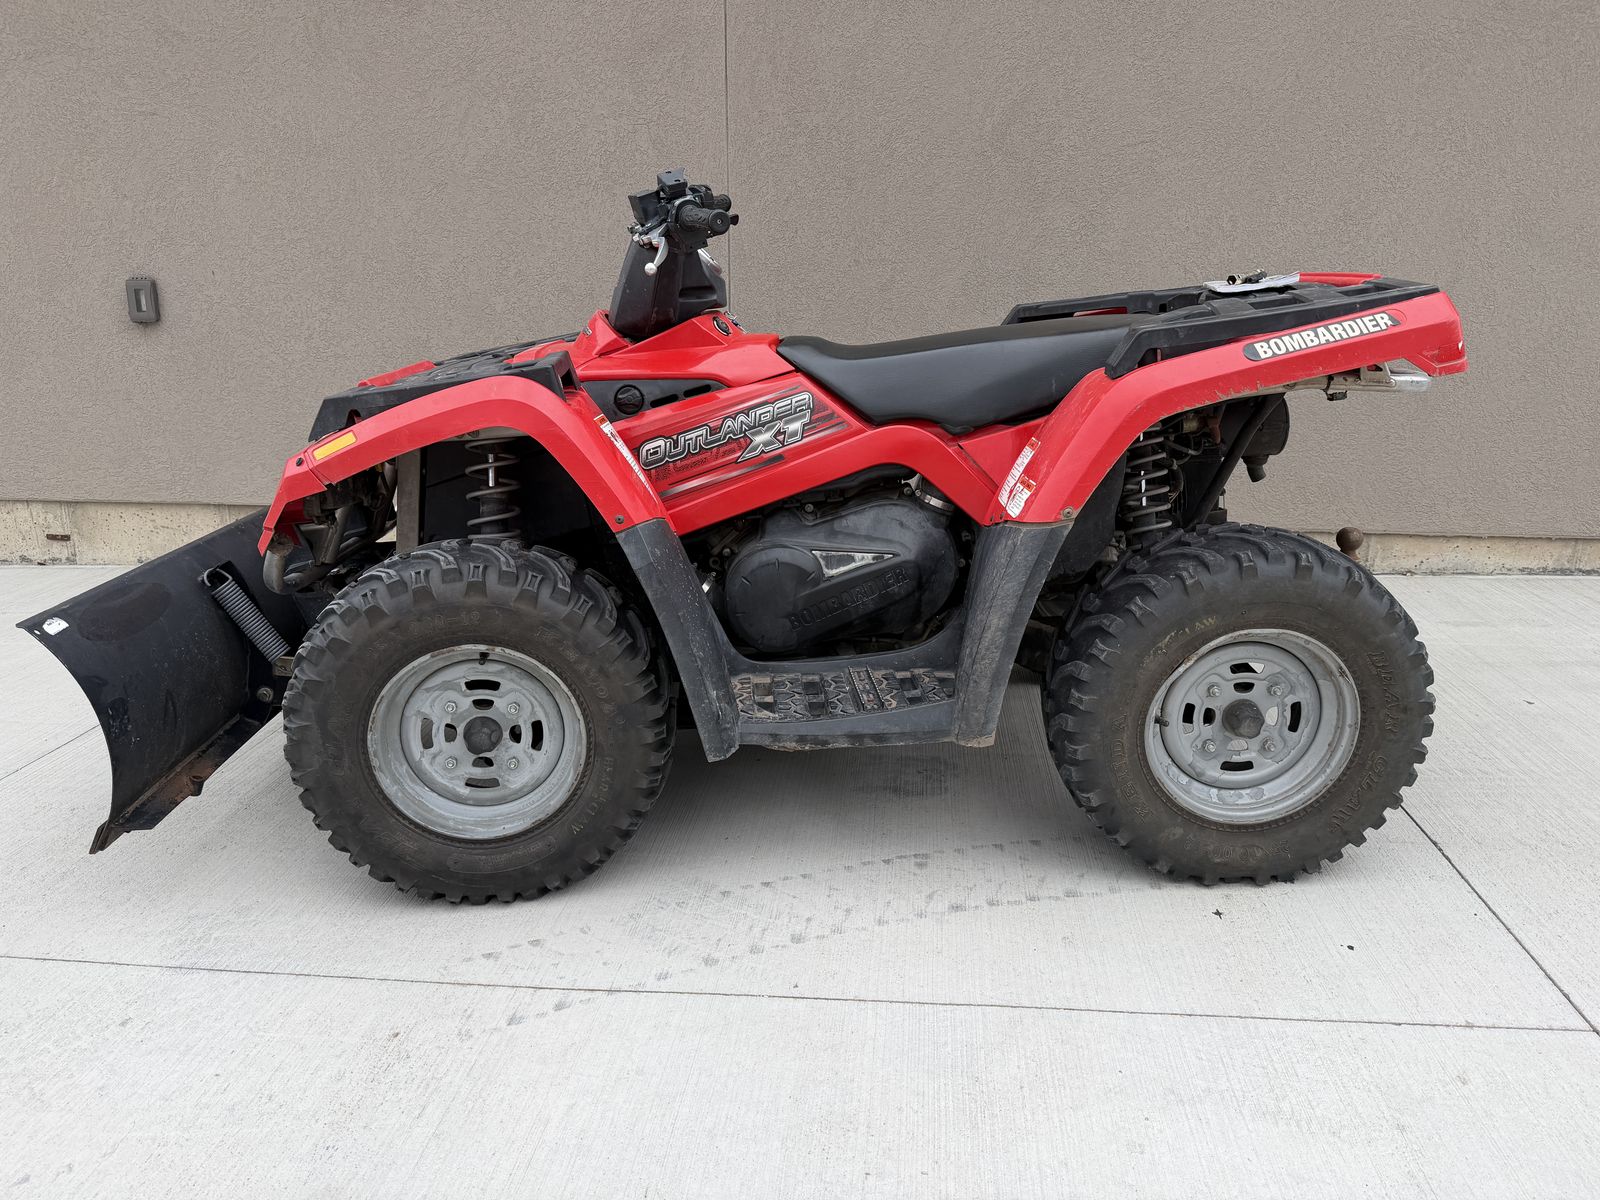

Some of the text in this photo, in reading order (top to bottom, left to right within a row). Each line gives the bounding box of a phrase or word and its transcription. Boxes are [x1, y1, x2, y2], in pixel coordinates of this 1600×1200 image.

[1253, 312, 1394, 360] BOMBARDIER
[639, 391, 814, 470] OUTLANDER
[736, 409, 811, 463] XT
